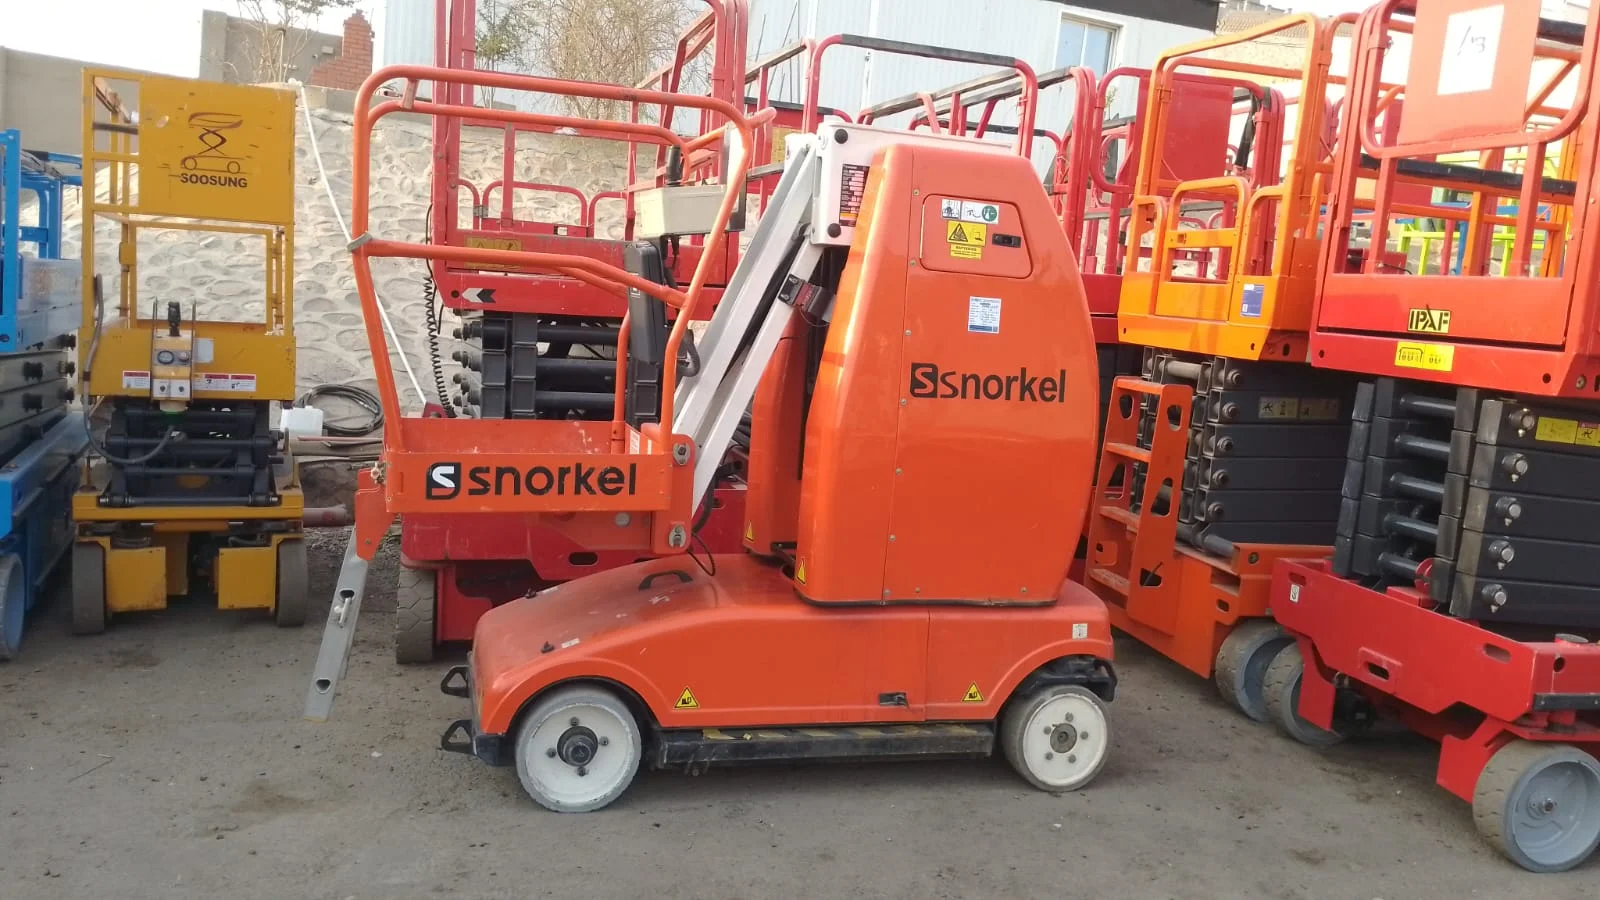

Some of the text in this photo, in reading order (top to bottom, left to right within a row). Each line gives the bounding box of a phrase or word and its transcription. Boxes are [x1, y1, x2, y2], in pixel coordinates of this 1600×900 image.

[180, 172, 248, 188] SOOSUNG
[1409, 304, 1449, 331] IPAF
[940, 367, 1066, 403] snorkel
[468, 463, 636, 496] snorkel
